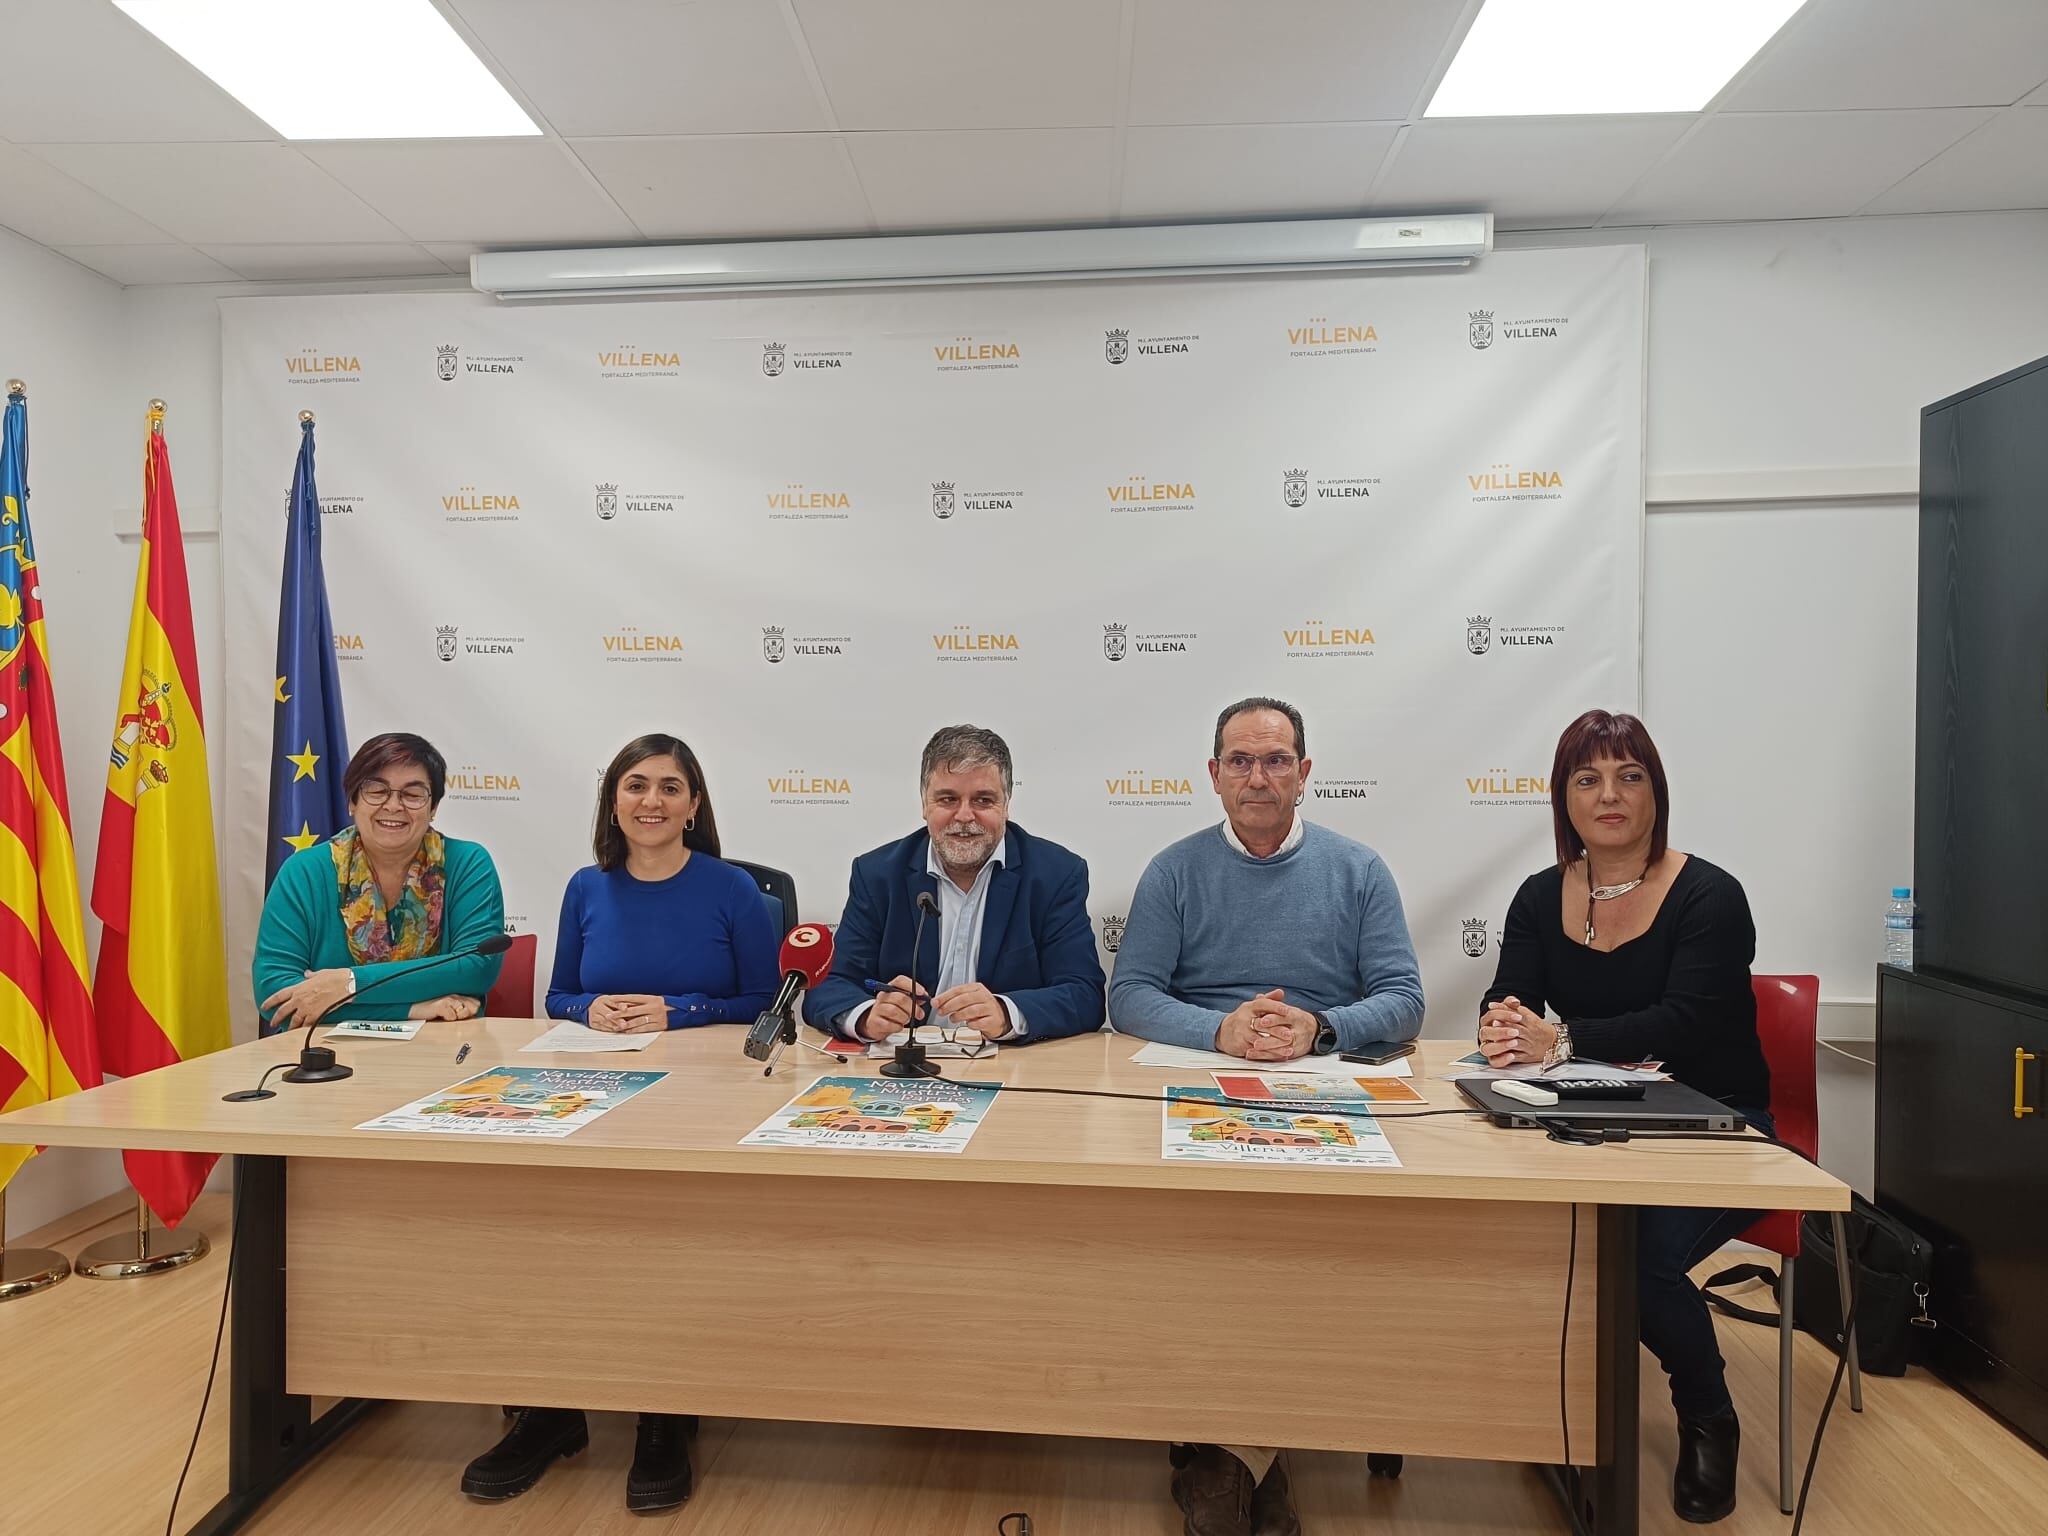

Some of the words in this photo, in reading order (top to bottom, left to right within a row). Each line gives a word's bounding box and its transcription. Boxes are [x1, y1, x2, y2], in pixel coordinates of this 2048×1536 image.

[1288, 325, 1378, 345] VILLENA
[1503, 327, 1558, 338] VILLENA
[934, 343, 1020, 361] VILLENA
[1138, 343, 1189, 355] VILLENA
[285, 356, 361, 373] VILLENA
[598, 352, 681, 367] VILLENA
[793, 359, 842, 369] VILLENA
[466, 363, 514, 374] VILLENA
[1468, 471, 1563, 490] VILLENA
[1107, 483, 1196, 502] VILLENA
[1317, 487, 1370, 498] VILLENA
[442, 495, 520, 511] VILLENA
[625, 502, 673, 512] VILLENA
[767, 493, 850, 508] VILLENA
[963, 500, 1013, 510] VILLENA
[320, 504, 353, 514] ILLENA
[602, 636, 683, 651] VILLENA
[933, 634, 1020, 650] VILLENA
[1283, 629, 1376, 646] VILLENA
[1500, 635, 1554, 646] VILLENA
[465, 644, 514, 654] VILLENA
[793, 645, 842, 655] VILLENA
[1135, 642, 1186, 652] VILLENA
[445, 774, 521, 791] VILLENA
[767, 778, 852, 794] VILLENA
[1105, 779, 1193, 795] VILLENA
[1466, 777, 1551, 794] VILLEN
[1314, 788, 1367, 799] VILLENA
[1220, 1142, 1286, 1154] Villena
